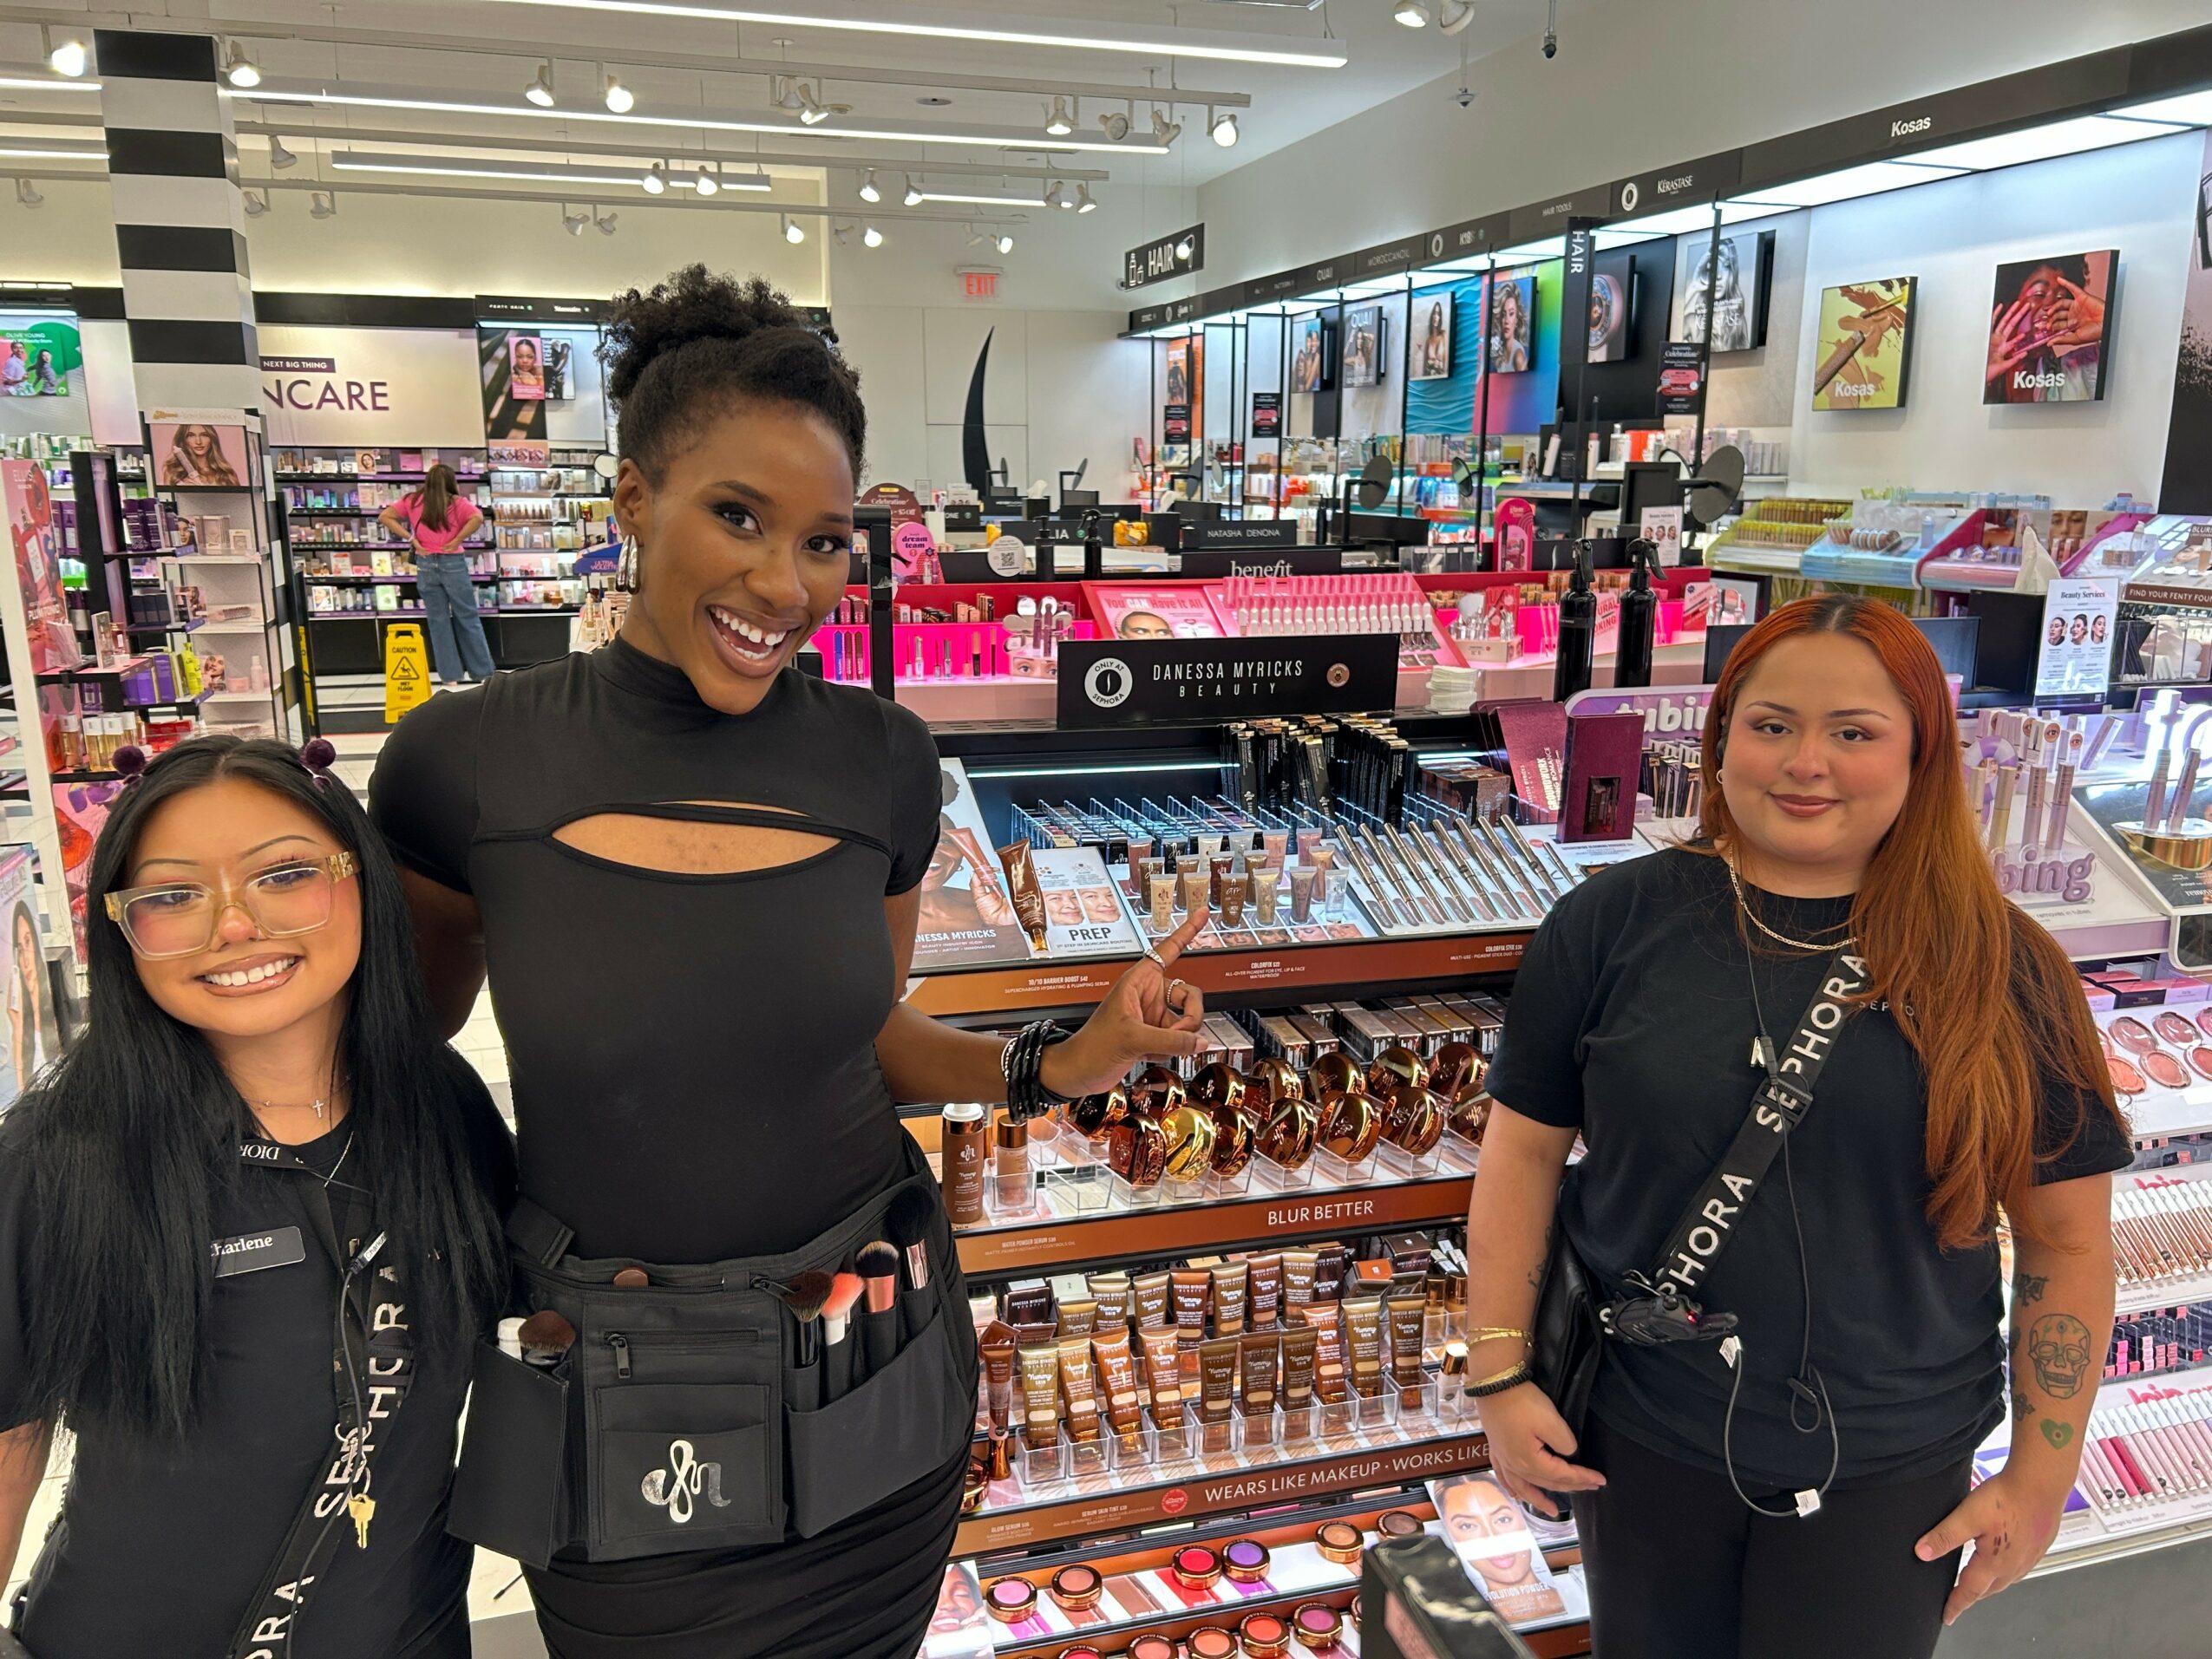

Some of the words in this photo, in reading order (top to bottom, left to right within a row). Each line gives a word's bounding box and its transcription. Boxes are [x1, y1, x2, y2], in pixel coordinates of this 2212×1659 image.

[1891, 116, 1932, 137] Kosas
[1571, 230, 1585, 274] HAIR
[1148, 243, 1175, 277] HAIR
[965, 274, 996, 295] EXIT
[2013, 370, 2066, 389] Kosas
[1834, 381, 1875, 397] Kosas
[1230, 559, 1293, 578] benefit
[2130, 589, 2147, 598] FIND
[2147, 591, 2169, 599] YOUR
[2169, 591, 2193, 601] FENTY
[1150, 598, 1178, 609] Have
[1095, 662, 1115, 672] ONLY
[1115, 663, 1125, 672] AT
[1153, 662, 1225, 681] DANESSA
[1233, 659, 1303, 678] MYRICKS
[1180, 682, 1276, 697] BEAUTY
[1092, 693, 1125, 704] SEPHORA
[951, 929, 997, 940] MYRICKS
[1068, 927, 1111, 942] PREP
[1043, 976, 1064, 985] BARRIER
[1267, 1206, 1311, 1226] BLUR
[1313, 1199, 1374, 1223] BETTER
[211, 1235, 273, 1257] harlene
[1286, 1272, 1311, 1282] Yummy
[1255, 1279, 1277, 1289] Yummy
[1221, 1289, 1242, 1297] Yummy
[1142, 1299, 1163, 1308] Yummy
[1177, 1297, 1202, 1305] Yummy
[1097, 1304, 1122, 1313] Yummy
[1353, 1326, 1378, 1336] Yummy
[1396, 1323, 1420, 1331] Yummy
[1247, 1360, 1272, 1369] Yummy
[1207, 1367, 1232, 1376] Yummy
[1205, 1479, 1267, 1503] WEARS
[1271, 1473, 1306, 1492] LIKE
[1310, 1461, 1381, 1486] MAKEUP
[1391, 1448, 1454, 1473] WORKS
[1457, 1442, 1490, 1461] LIKE
